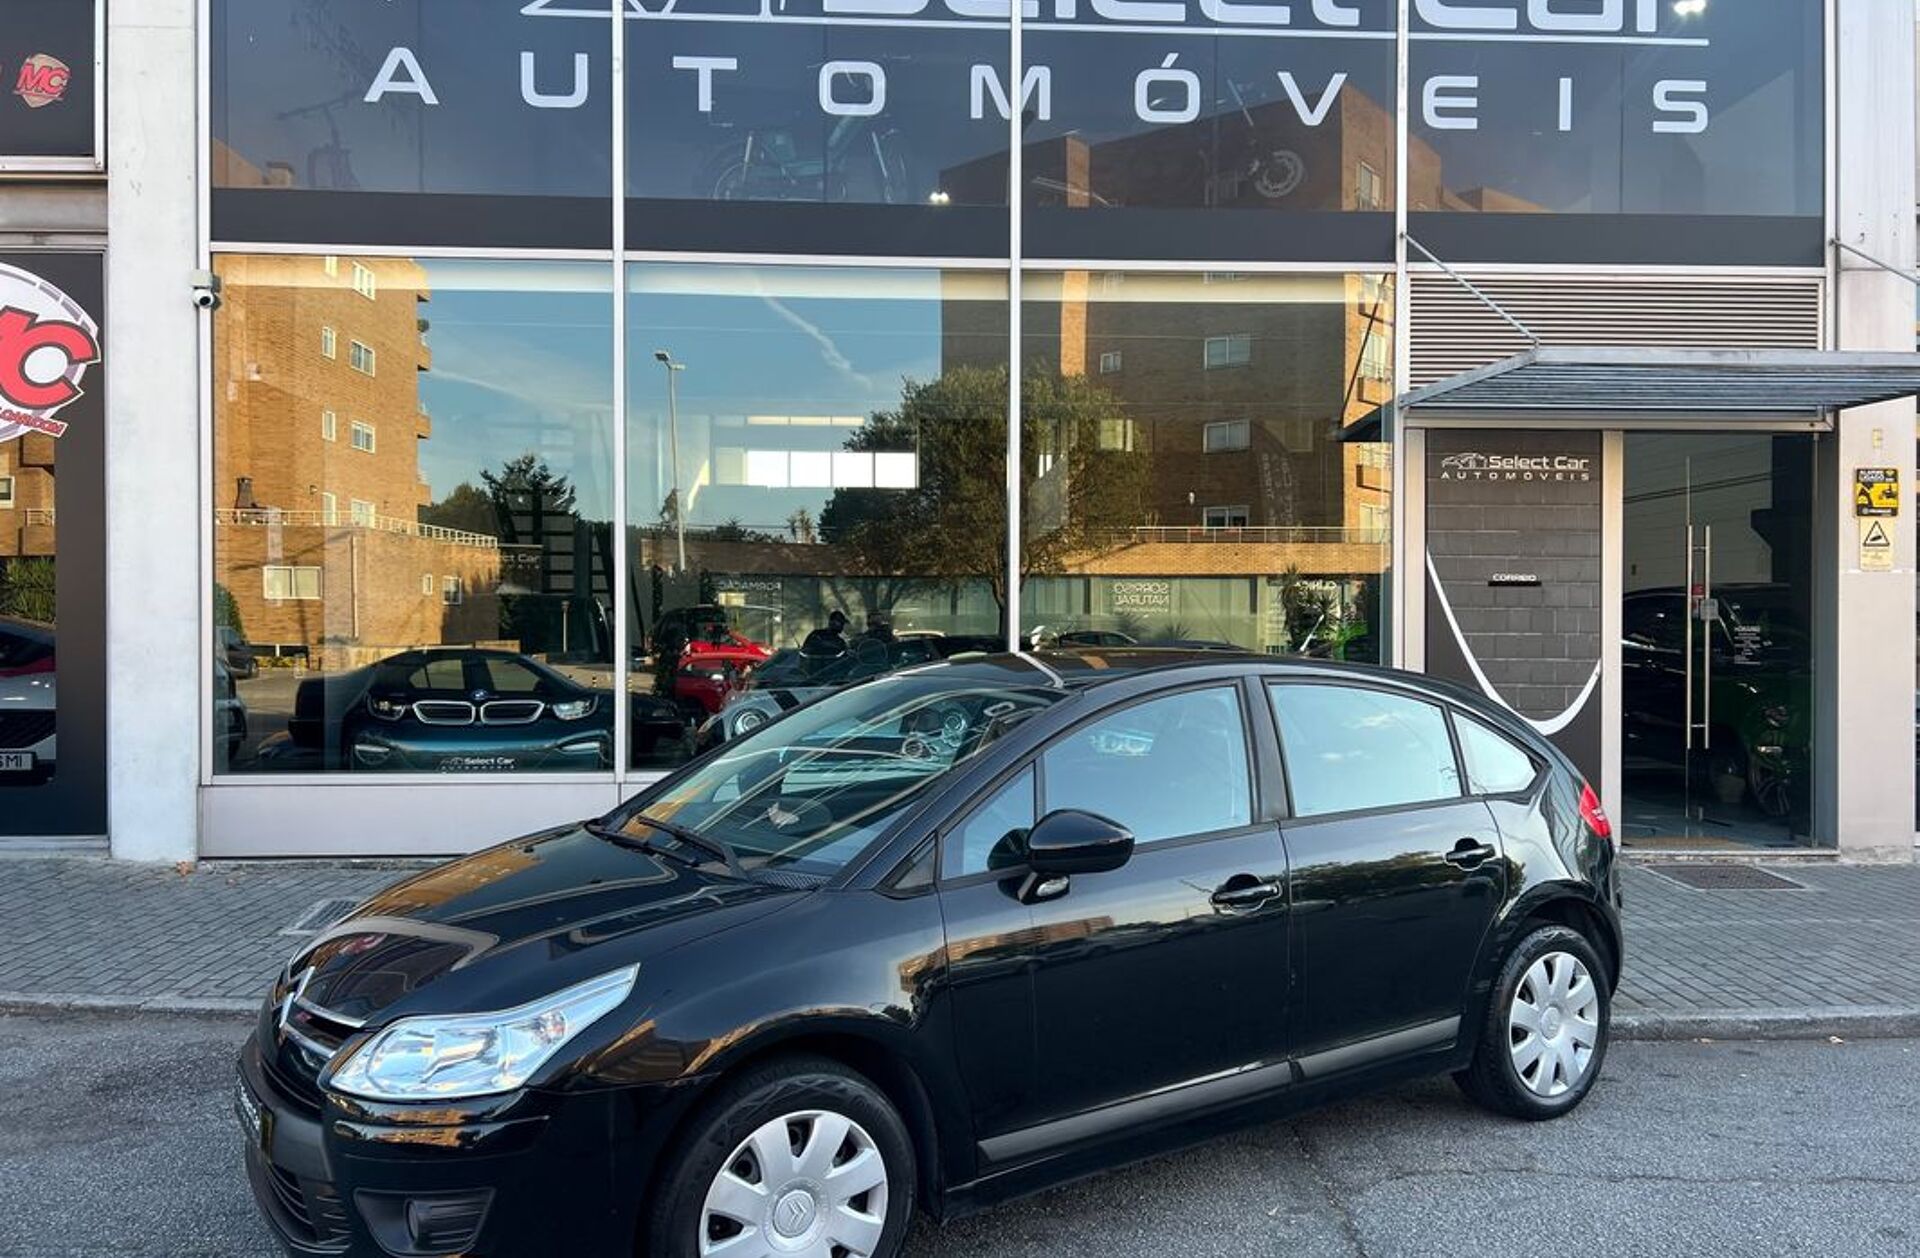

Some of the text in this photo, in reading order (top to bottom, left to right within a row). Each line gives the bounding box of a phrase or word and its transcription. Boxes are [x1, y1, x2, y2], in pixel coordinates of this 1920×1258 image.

[364, 45, 1709, 134] AUTOMÓVEIS
[1489, 455, 1590, 470] Select Car
